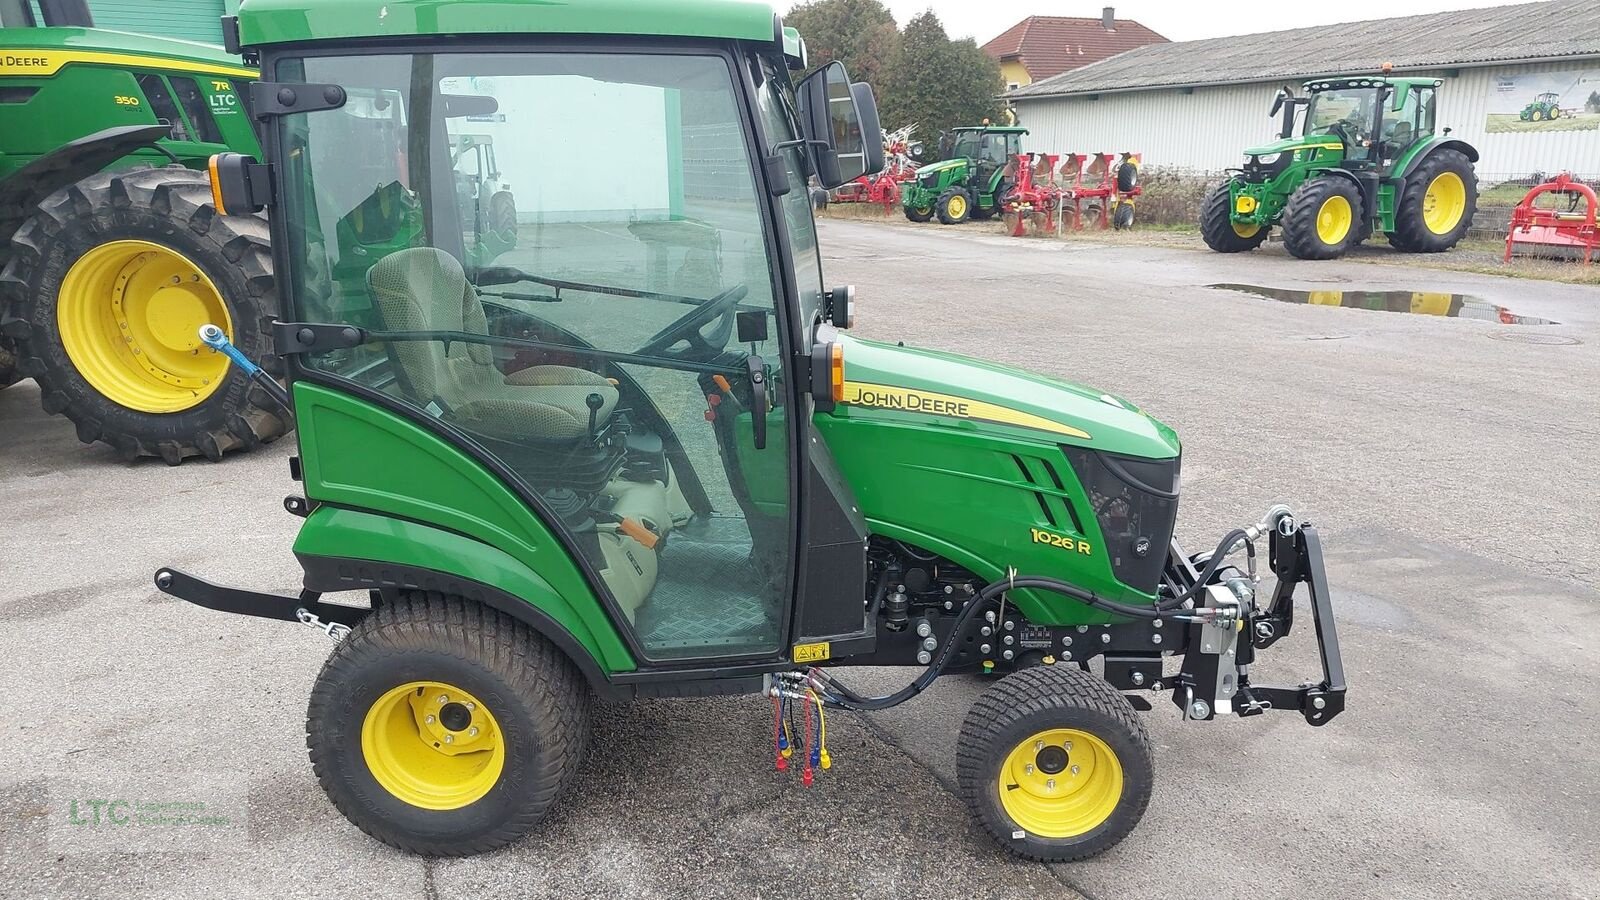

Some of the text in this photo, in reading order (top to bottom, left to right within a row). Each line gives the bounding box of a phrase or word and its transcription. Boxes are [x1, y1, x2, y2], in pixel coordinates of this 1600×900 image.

[6, 56, 49, 67] DEERE
[211, 81, 231, 91] 7R
[114, 95, 140, 106] 350
[209, 94, 236, 107] LTC
[852, 388, 969, 416] JOHN DEERE
[1030, 528, 1092, 555] 1026 R
